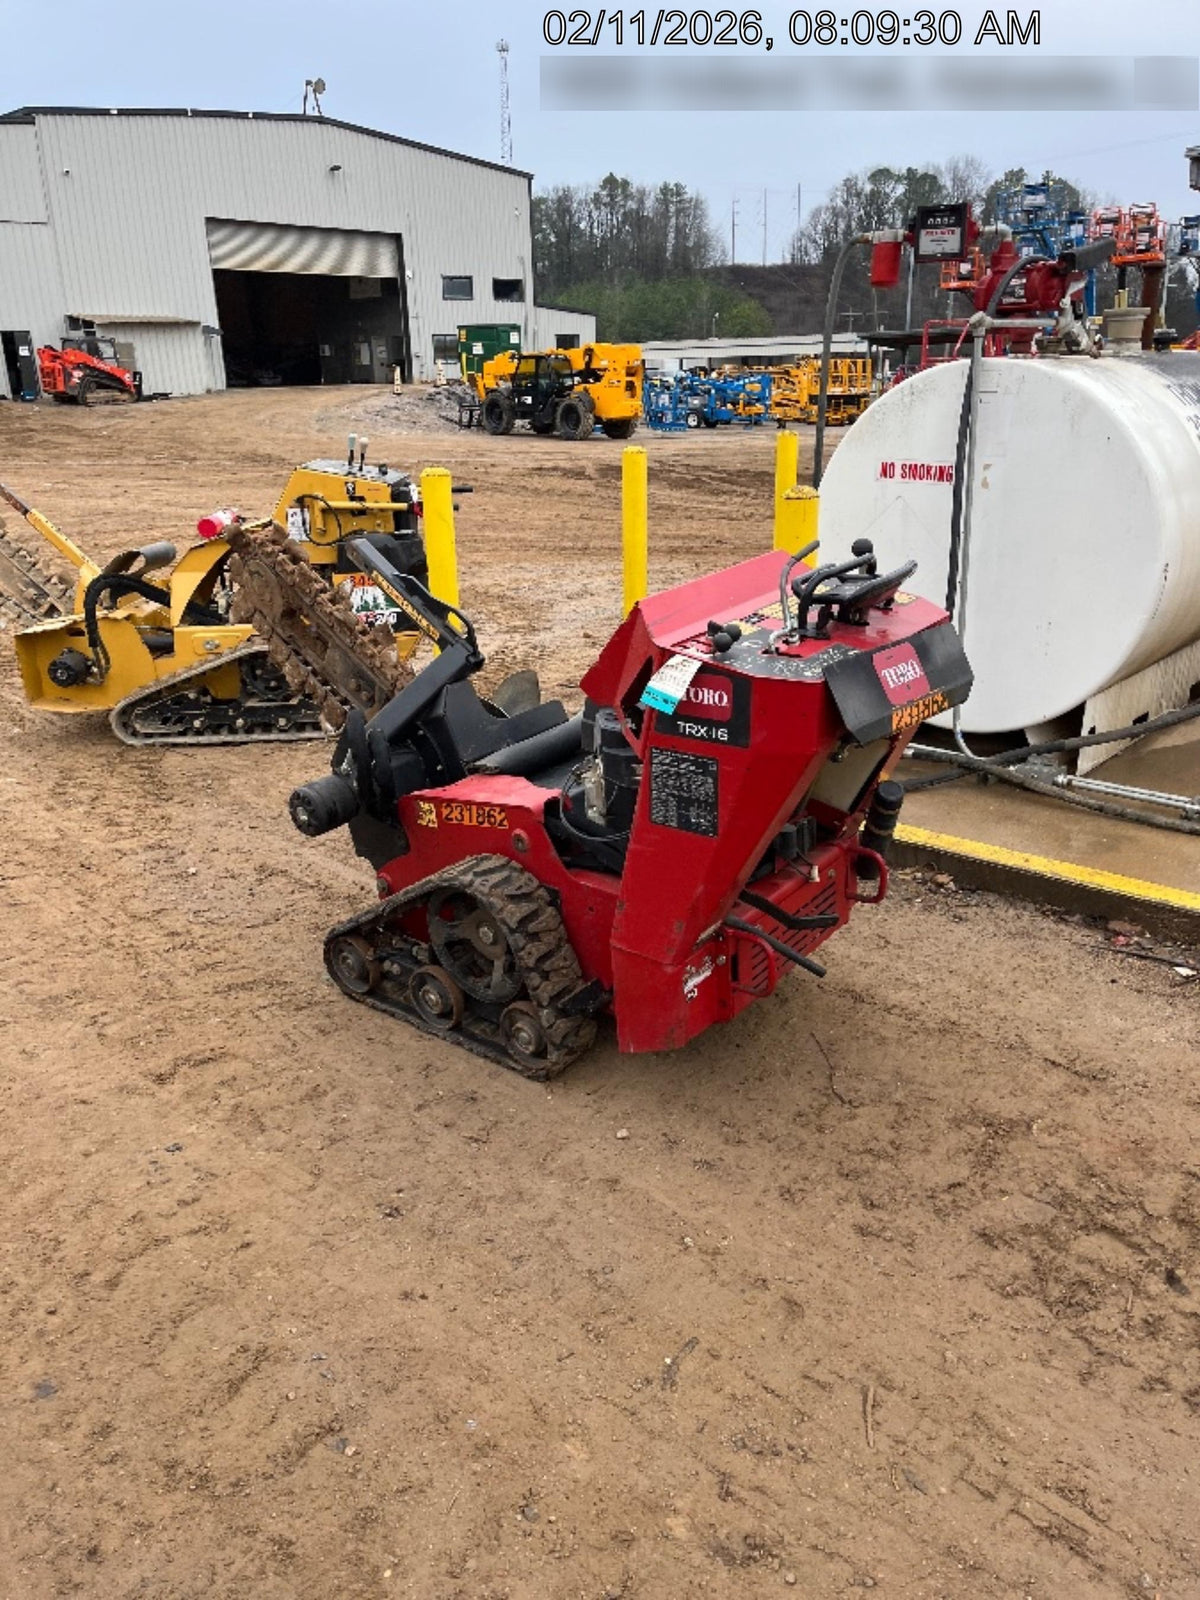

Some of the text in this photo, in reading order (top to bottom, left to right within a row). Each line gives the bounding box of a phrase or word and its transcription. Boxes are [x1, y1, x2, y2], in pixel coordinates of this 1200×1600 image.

[880, 461, 953, 483] NO SMOKING
[881, 659, 924, 689] TORO
[893, 689, 949, 732] 231862
[443, 802, 508, 829] 231862
